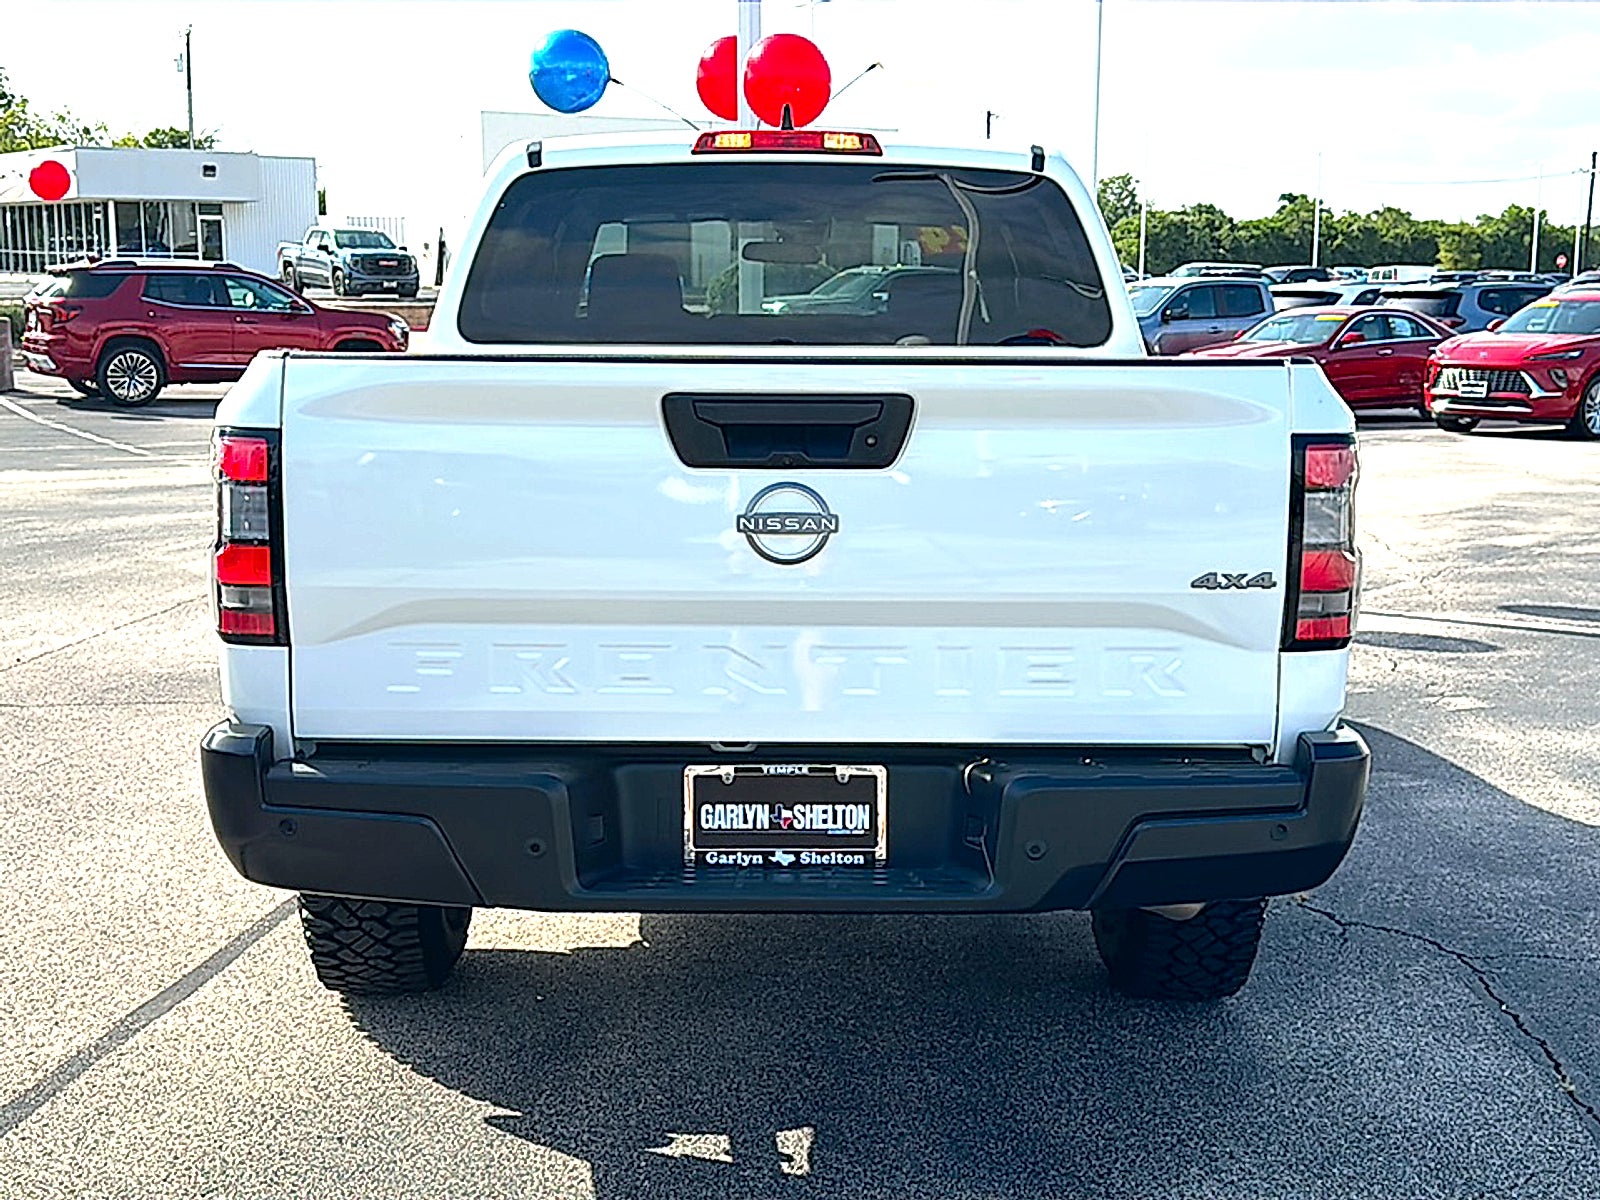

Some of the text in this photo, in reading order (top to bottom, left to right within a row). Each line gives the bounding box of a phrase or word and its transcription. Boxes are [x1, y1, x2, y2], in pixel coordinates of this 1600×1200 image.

[739, 517, 836, 531] NISSAN
[386, 643, 1188, 696] FRONTIER
[762, 764, 809, 776] TEMPLE
[700, 803, 870, 830] GARLYN SHELTON
[705, 851, 865, 867] Garlyn Shelton
